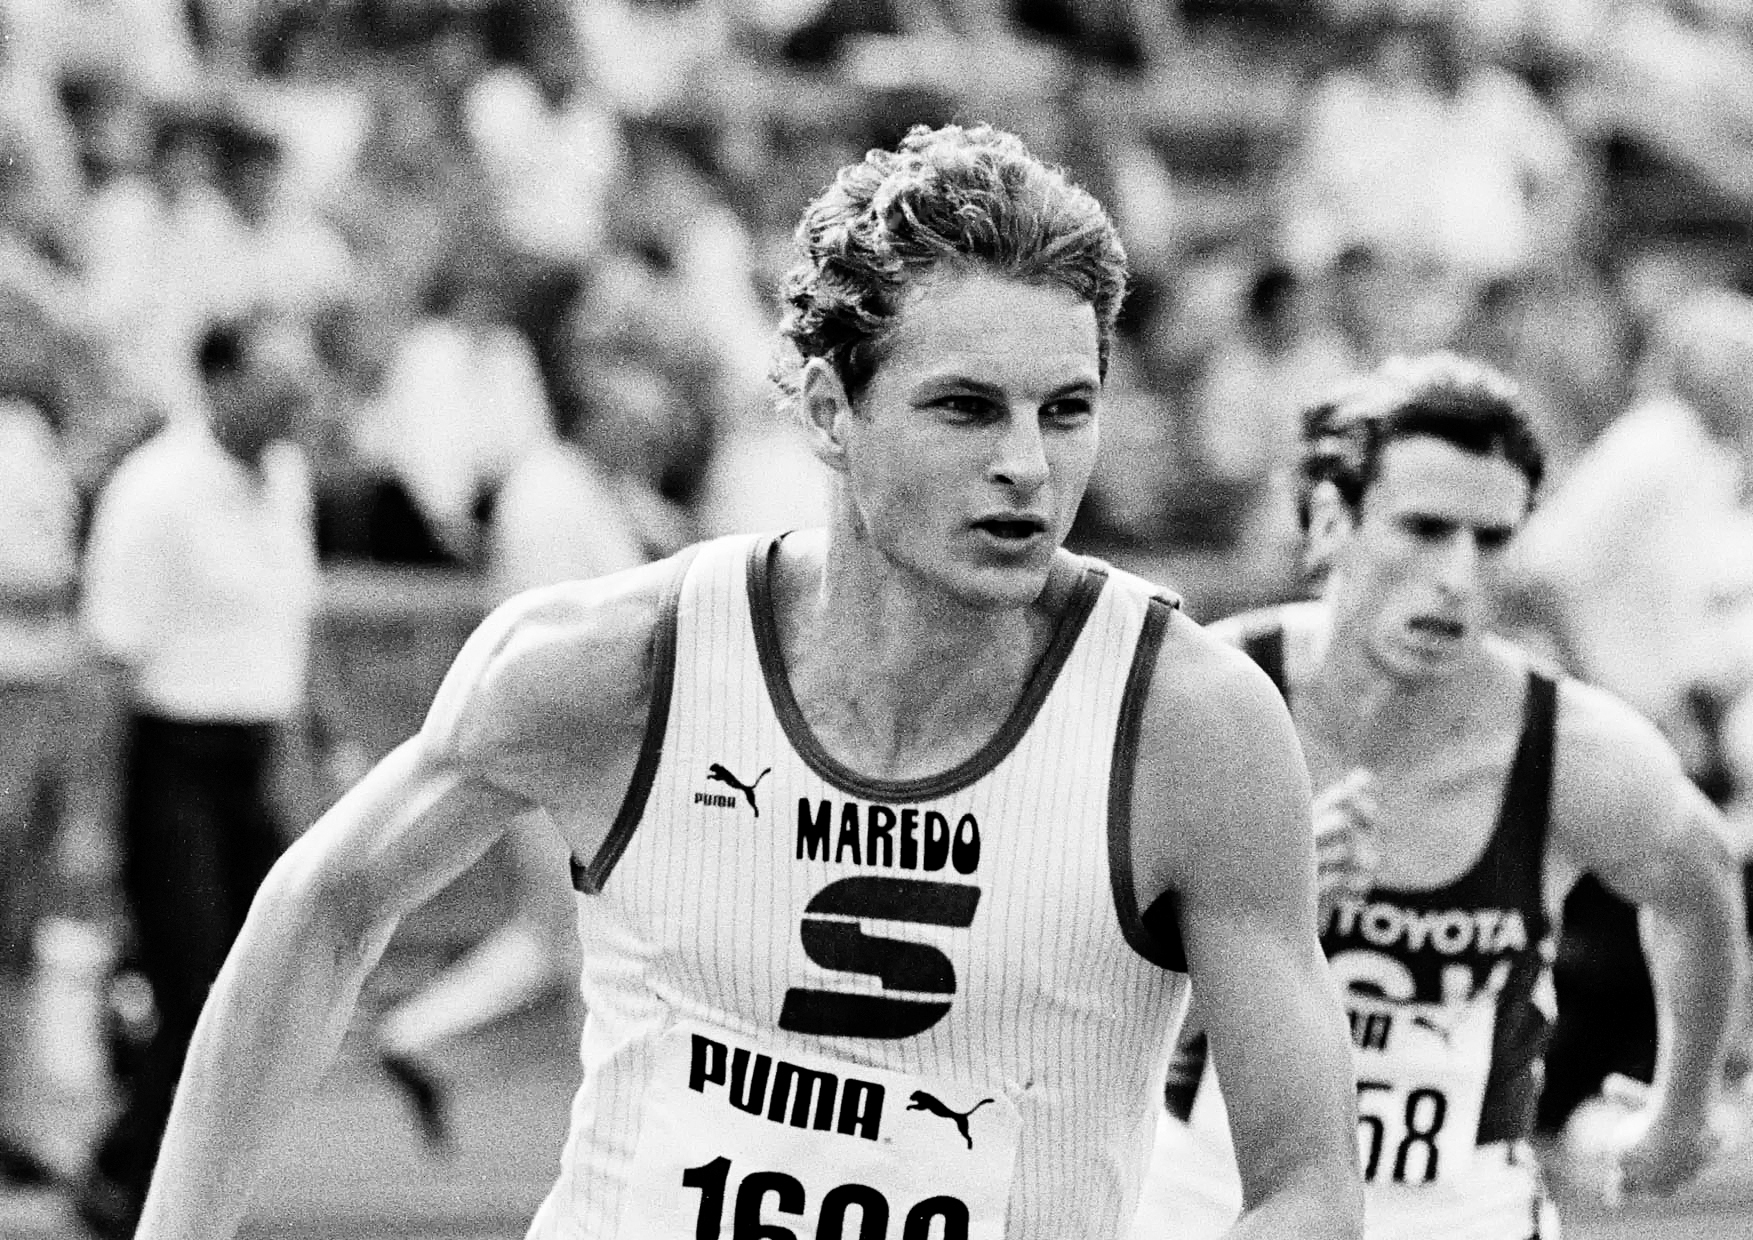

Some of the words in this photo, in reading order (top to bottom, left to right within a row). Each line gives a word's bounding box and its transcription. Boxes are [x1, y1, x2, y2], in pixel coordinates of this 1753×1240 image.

[694, 792, 736, 809] PUMA
[796, 797, 981, 875] MAREDO
[1336, 900, 1527, 954] TOYOTA
[688, 1033, 885, 1141] PUMA
